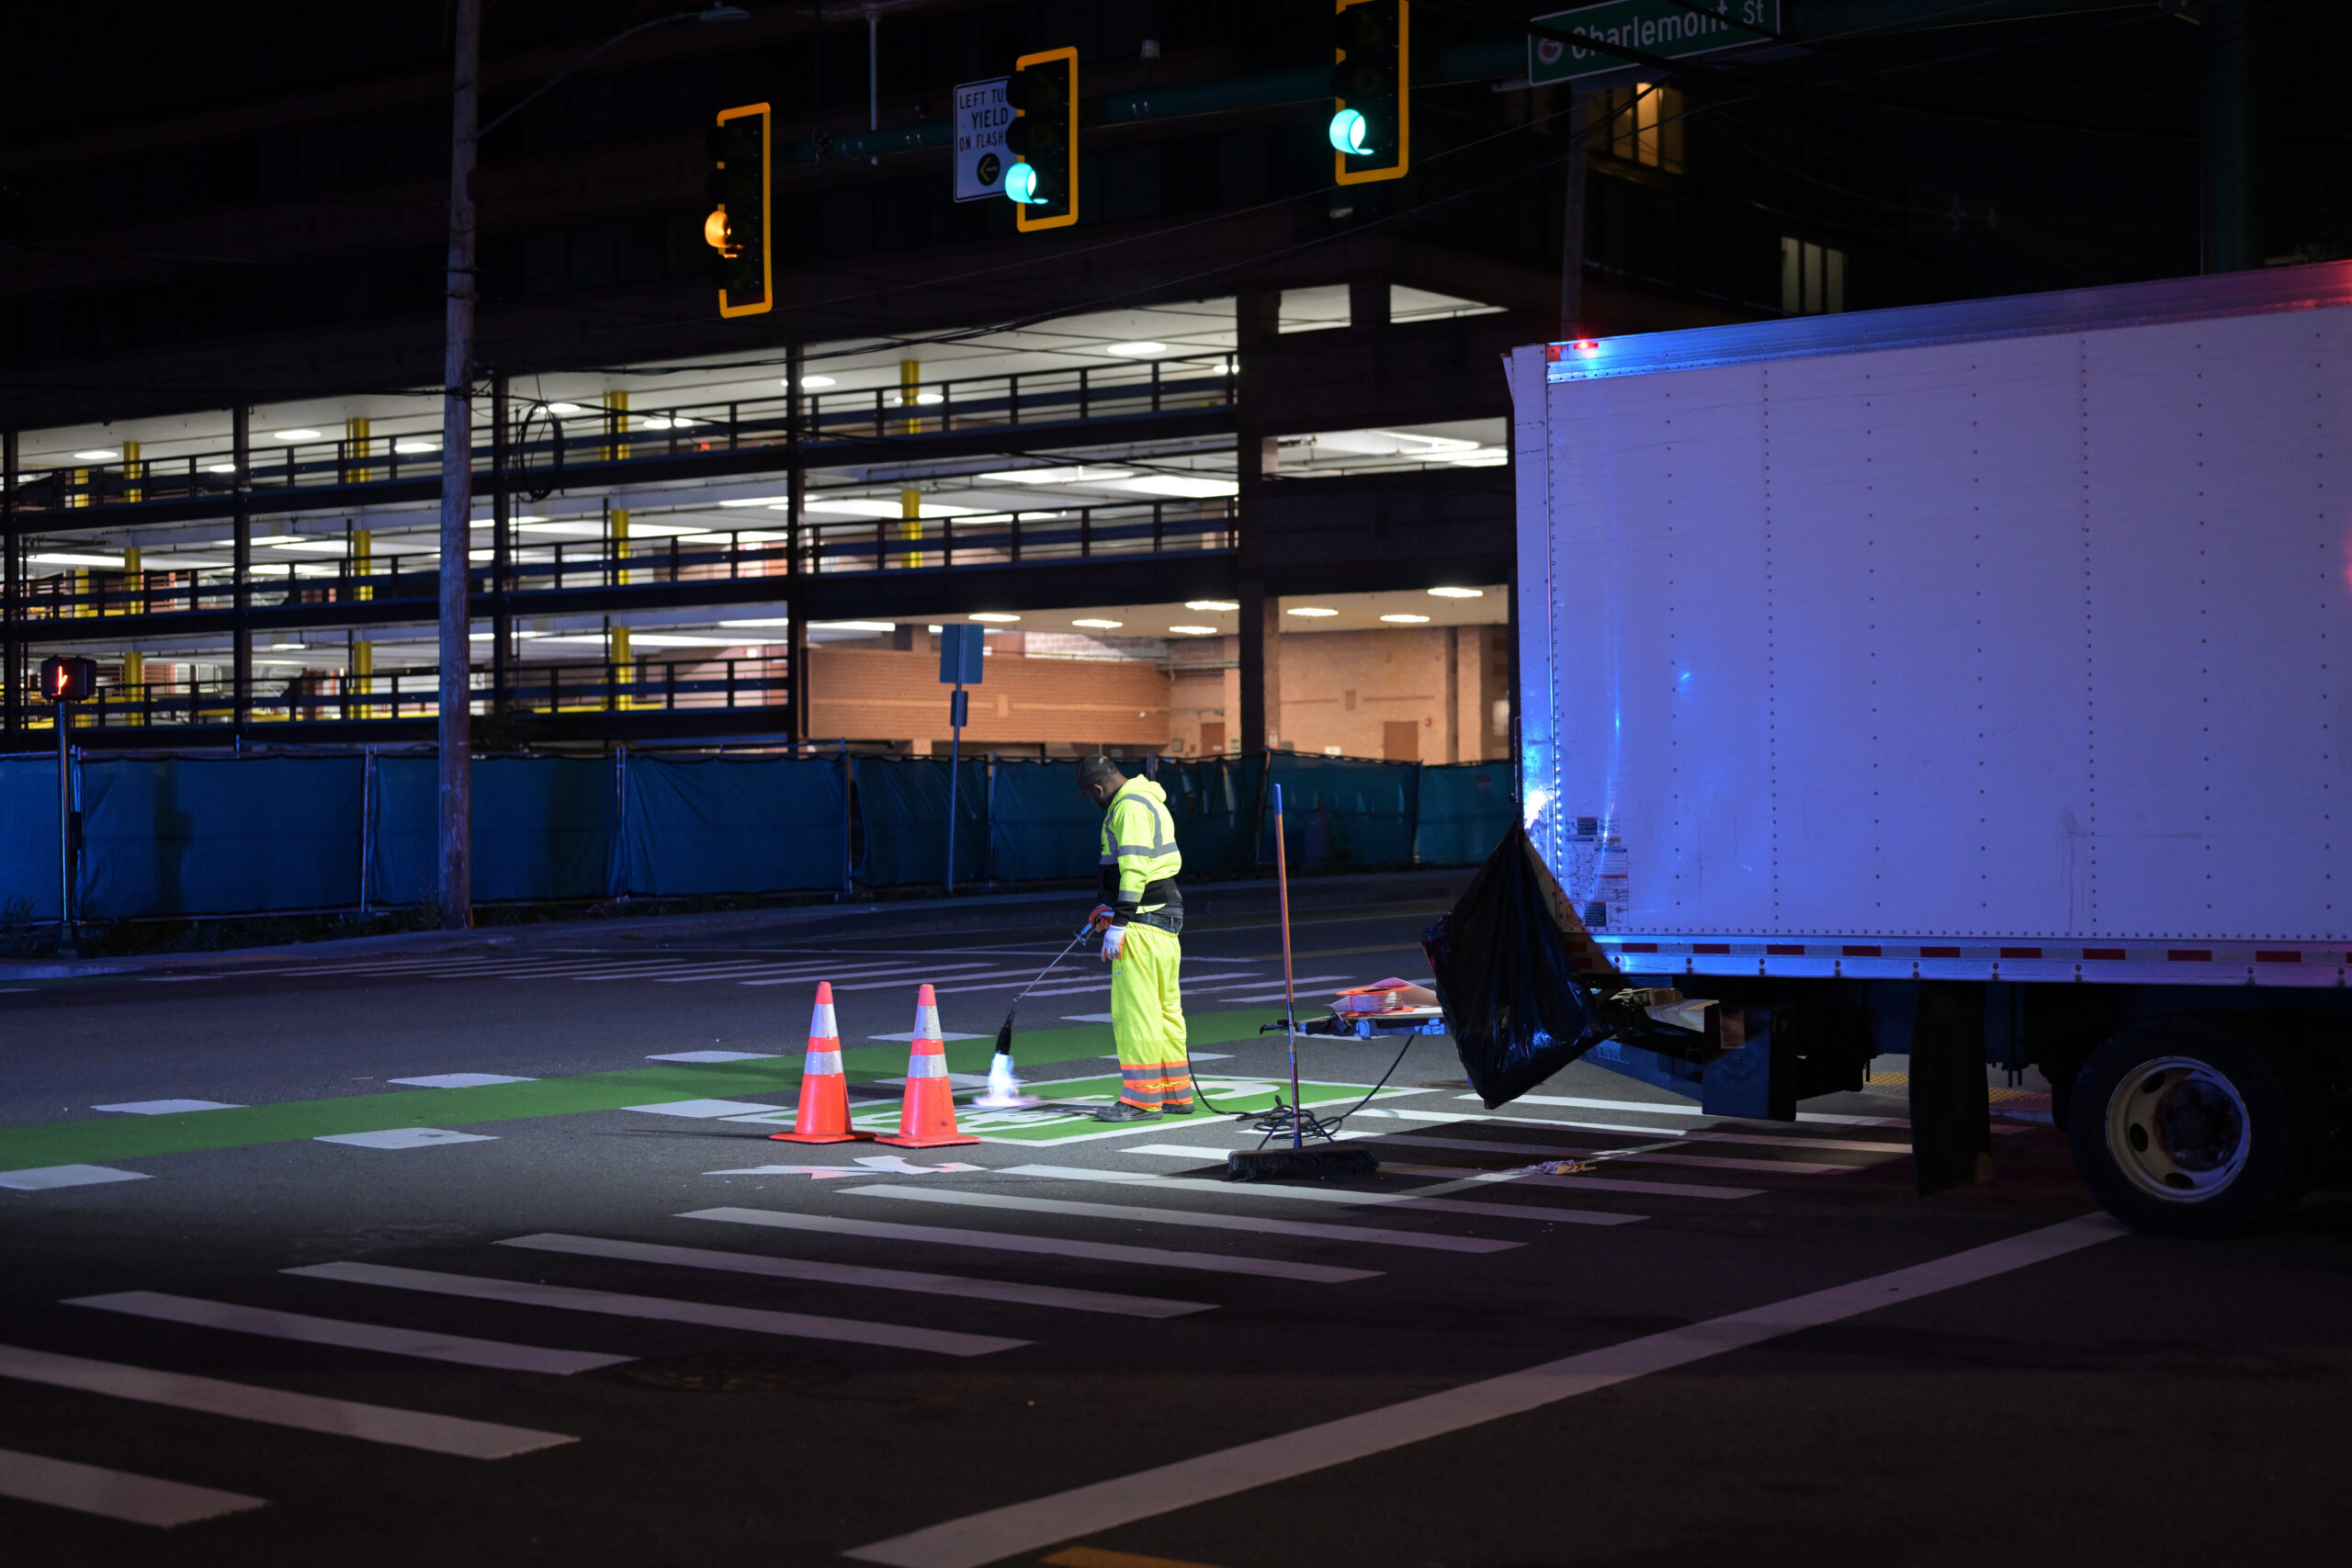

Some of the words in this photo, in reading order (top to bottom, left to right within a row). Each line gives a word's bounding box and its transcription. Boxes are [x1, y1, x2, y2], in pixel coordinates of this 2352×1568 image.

[1572, 0, 1728, 60] Charlemont
[1743, 0, 1764, 25] St
[960, 91, 986, 109] LEFT
[991, 88, 1004, 104] TU
[971, 107, 1008, 130] YIELD
[960, 136, 971, 152] ON
[977, 130, 1005, 149] FLASH
